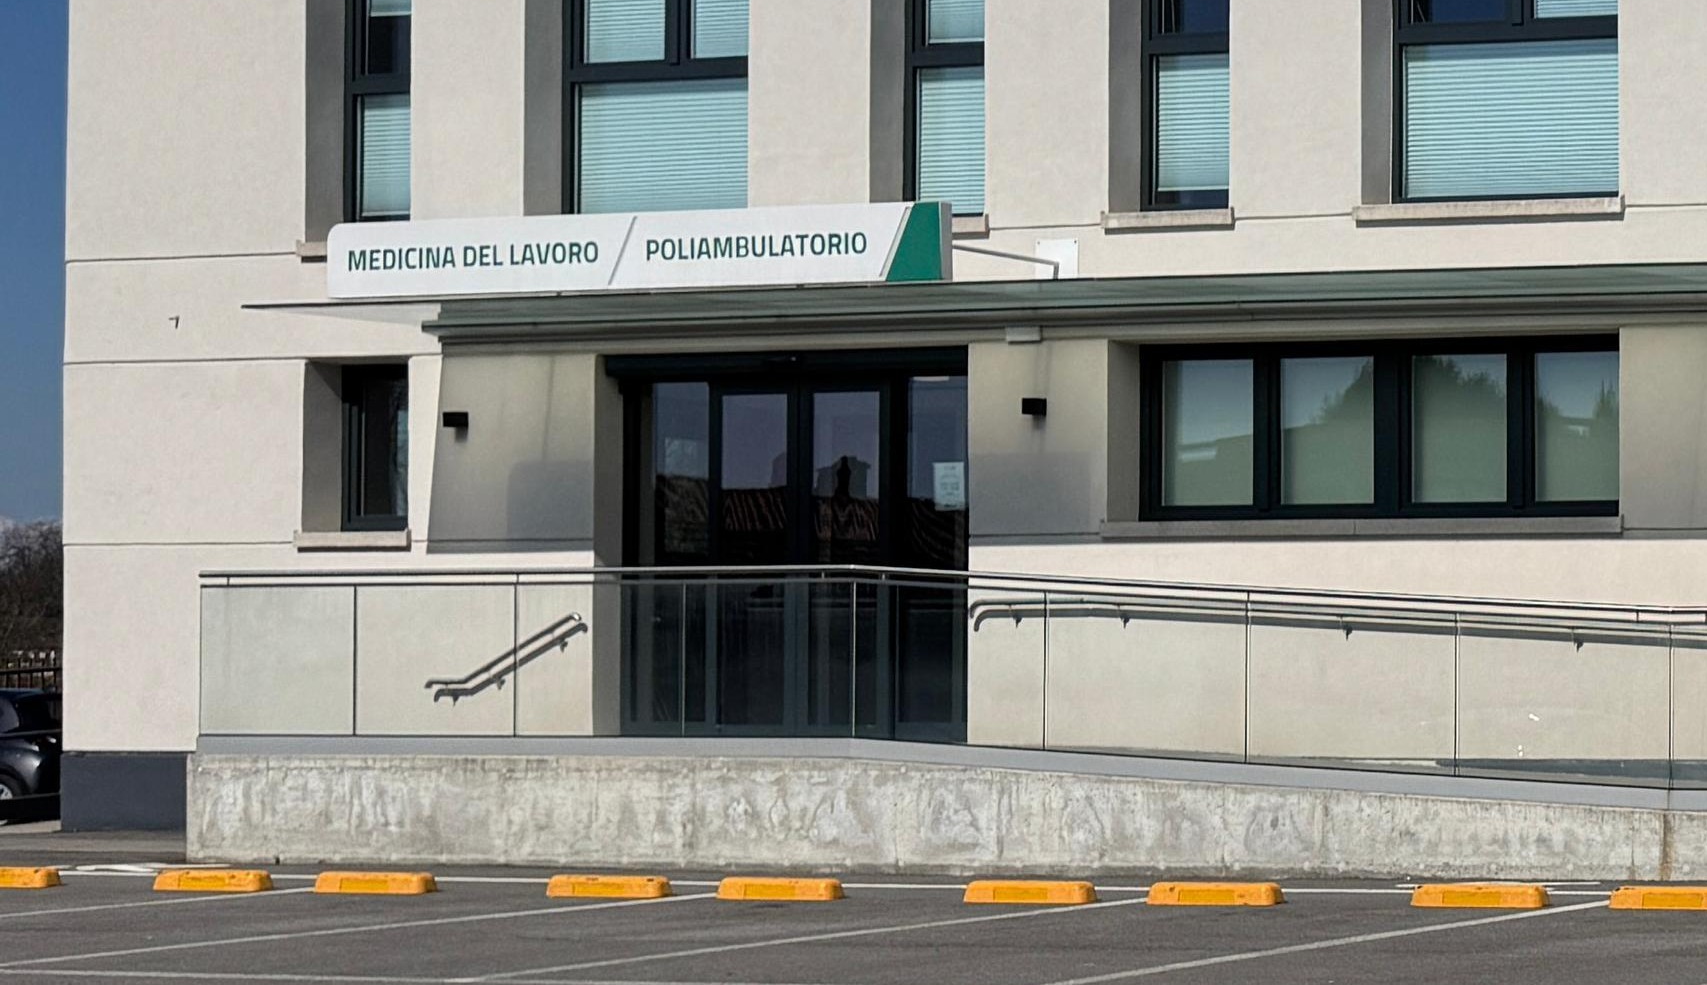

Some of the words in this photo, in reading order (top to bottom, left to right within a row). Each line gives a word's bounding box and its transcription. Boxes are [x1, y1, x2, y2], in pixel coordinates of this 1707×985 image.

[347, 246, 456, 272] MEDICINA
[463, 244, 504, 268] DEL
[510, 240, 599, 266] LAVORO
[646, 231, 868, 262] POLIAMBULATORIO
